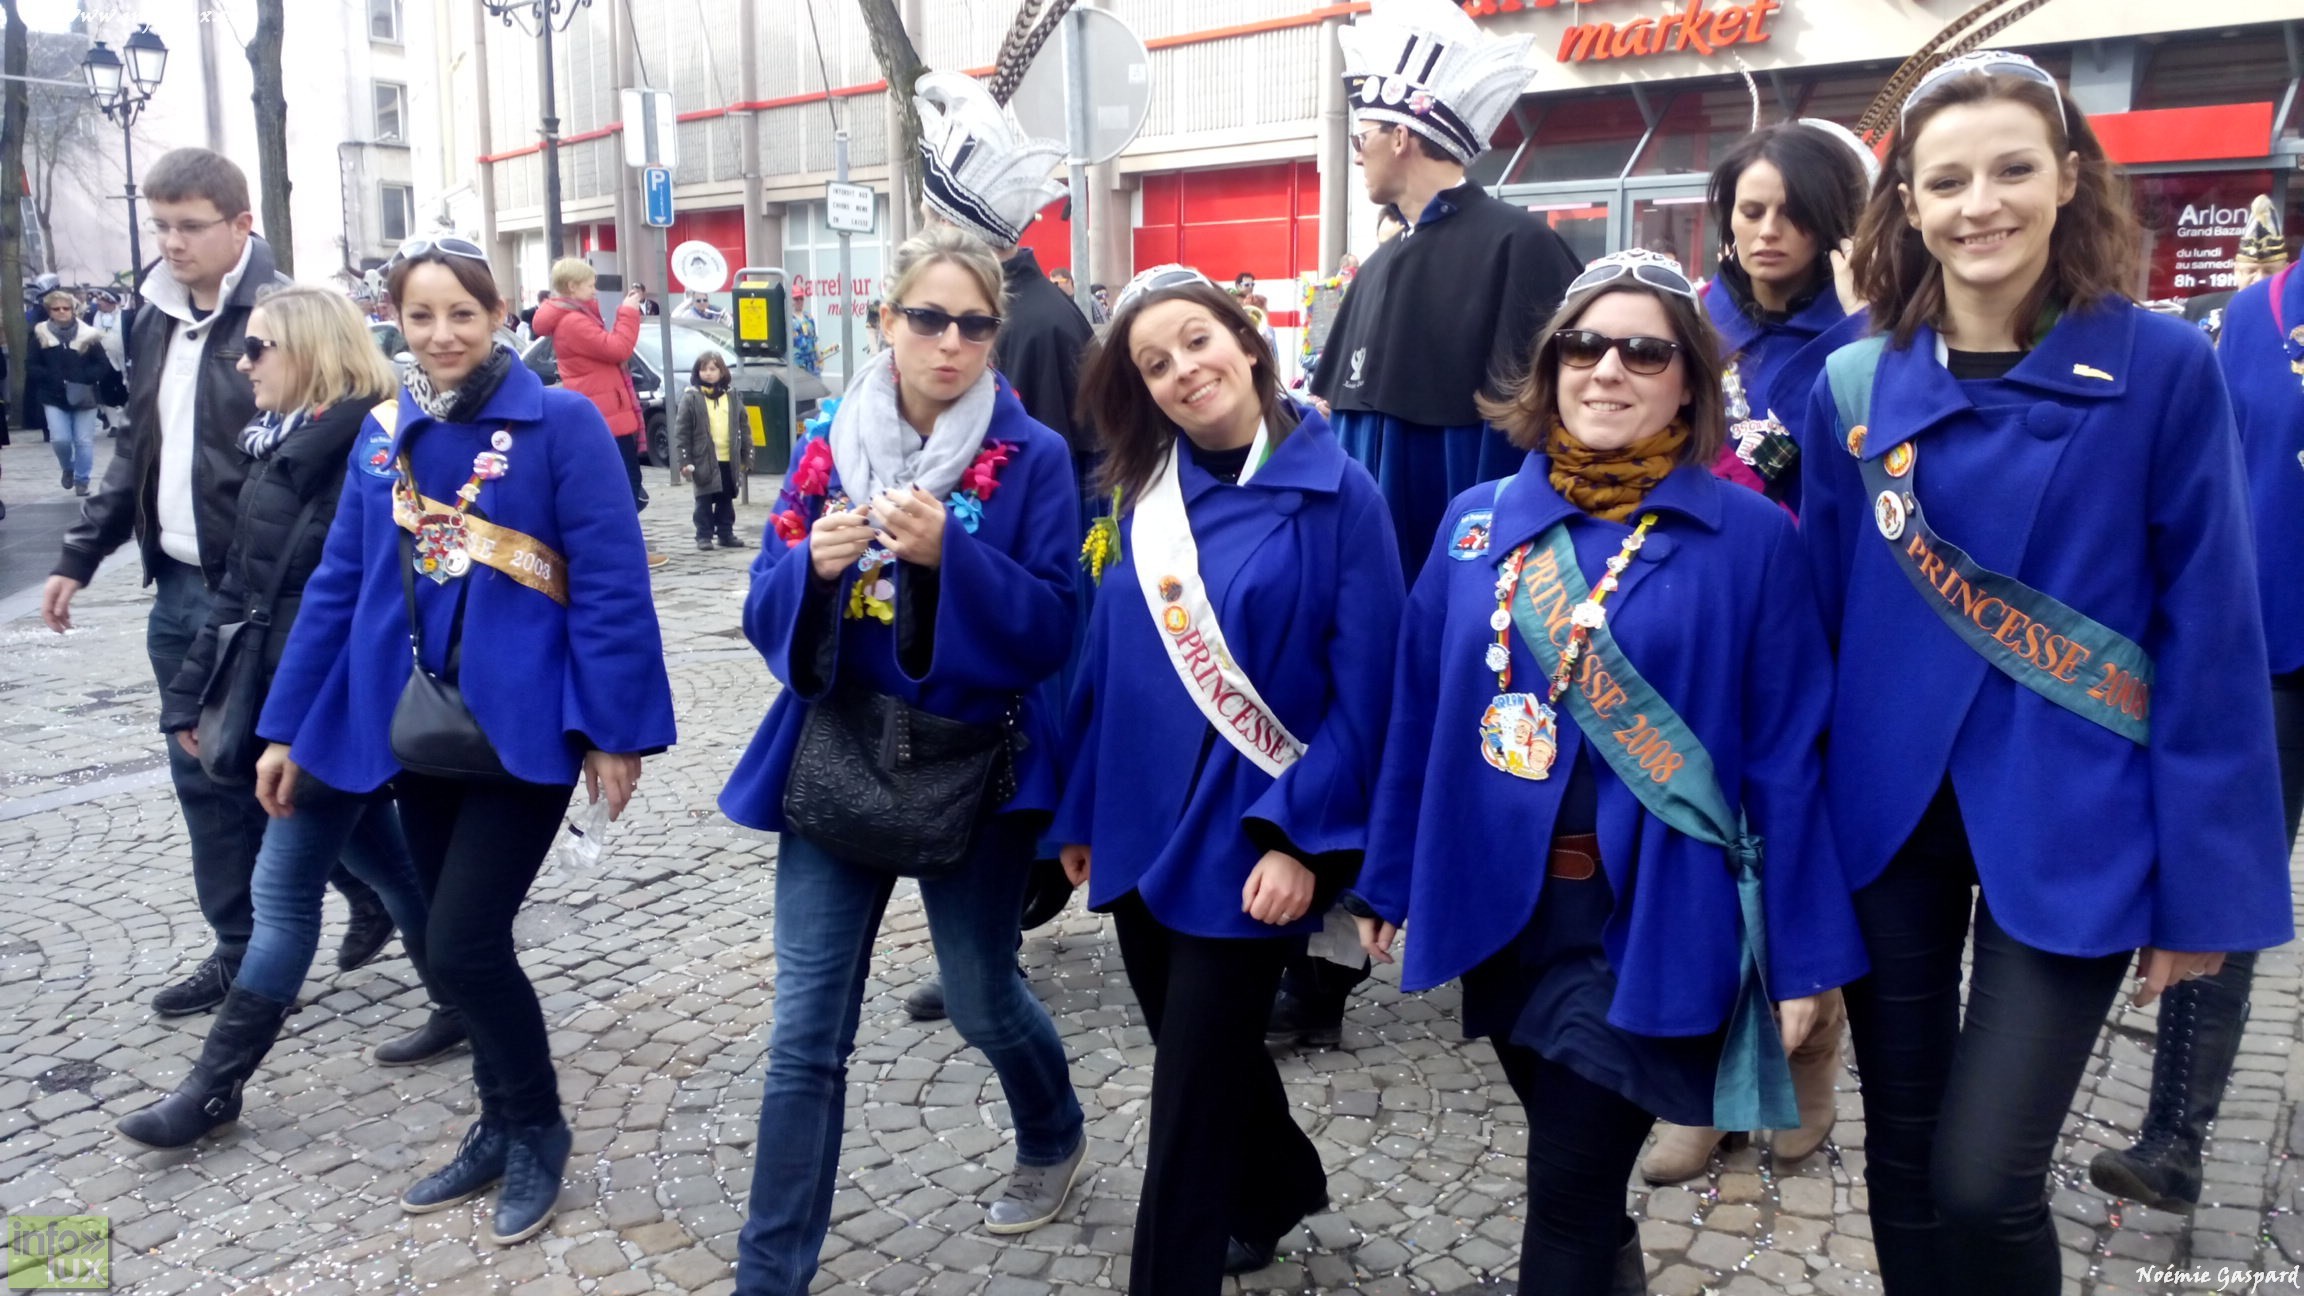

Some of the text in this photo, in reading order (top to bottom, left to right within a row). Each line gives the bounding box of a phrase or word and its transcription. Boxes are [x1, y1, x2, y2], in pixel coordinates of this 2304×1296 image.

[1557, 0, 1782, 63] market
[651, 170, 666, 191] P
[2177, 204, 2249, 226] Arlon
[2177, 227, 2212, 237] Grand
[2176, 247, 2222, 258] du lundi
[2175, 261, 2190, 270] au
[2174, 274, 2195, 287] 8h
[1906, 531, 2091, 684] PRINCESSE
[1175, 626, 1290, 765] PRINCESSE
[1612, 713, 1685, 784] 2008
